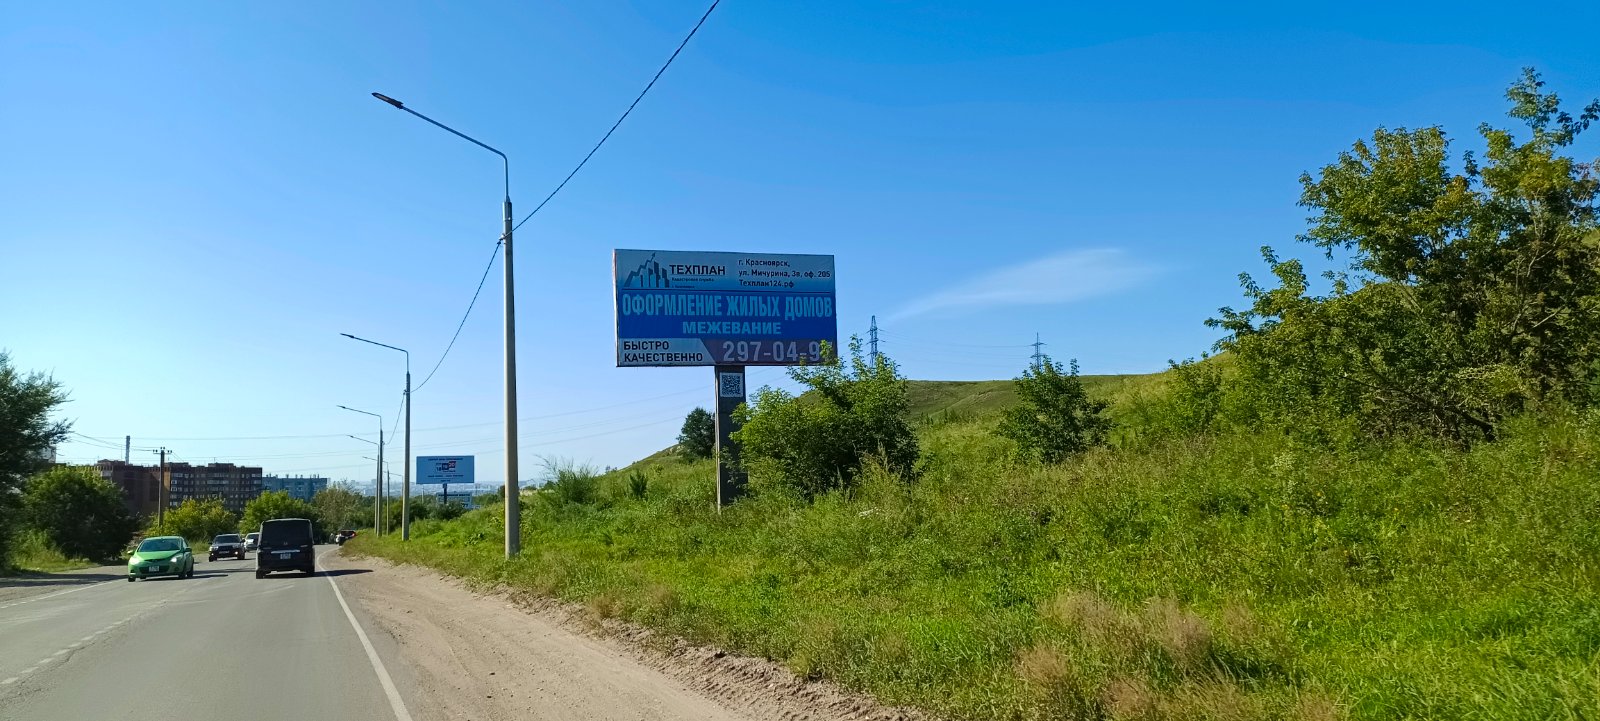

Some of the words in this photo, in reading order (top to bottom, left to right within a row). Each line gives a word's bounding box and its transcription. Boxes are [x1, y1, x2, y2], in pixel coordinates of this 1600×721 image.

[745, 259, 790, 267] Красноярск,
[669, 264, 726, 275] ТЕХПЛАН
[751, 269, 790, 278] Мичурина,
[622, 293, 722, 316] ОФОРМЛЕНИЕ
[726, 295, 780, 317] ЖИЛЫХ
[784, 296, 833, 321] ДОМОВ
[682, 321, 782, 335] МЕЖЕВАНИЕ
[623, 340, 670, 351] БЫСТРО
[722, 341, 833, 362] 297-04-9
[624, 352, 703, 363] КАЧЕСТВЕННО
